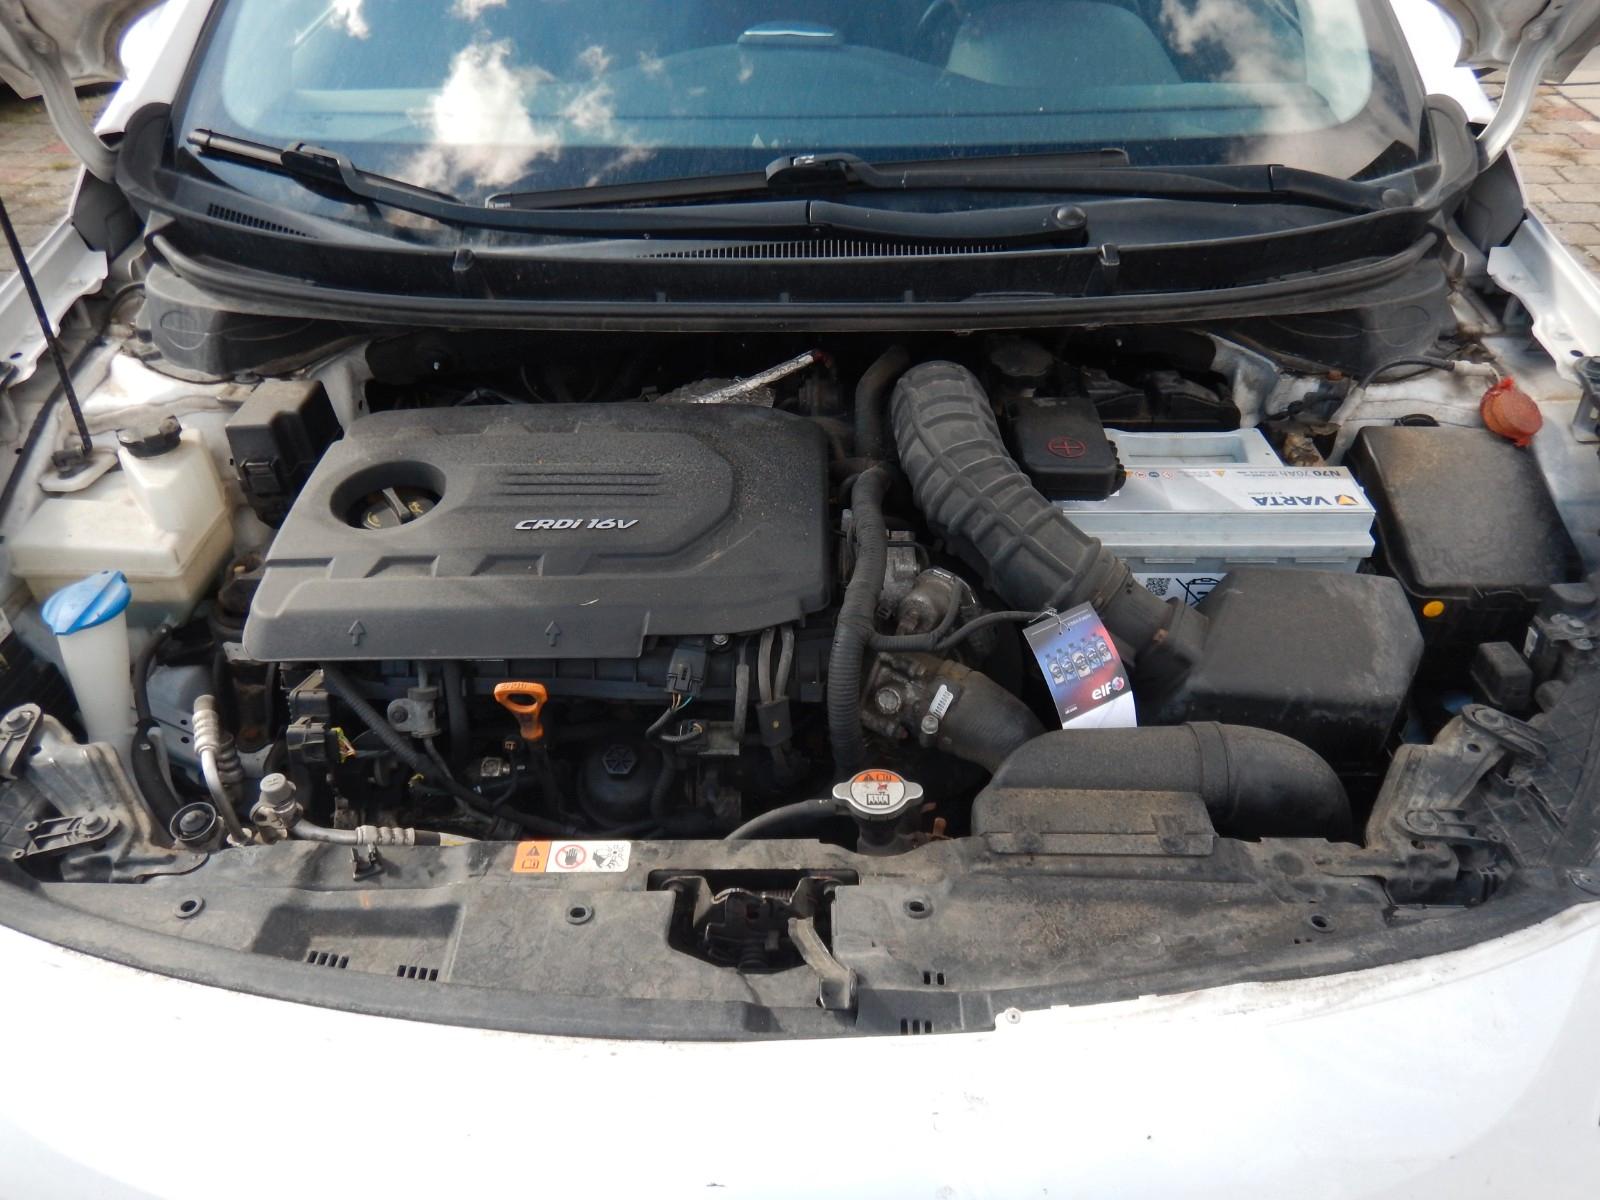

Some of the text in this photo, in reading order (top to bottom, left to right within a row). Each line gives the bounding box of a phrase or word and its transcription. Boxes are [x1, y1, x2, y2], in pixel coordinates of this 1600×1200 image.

[1250, 495, 1332, 506] VARTA
[586, 518, 639, 530] 16V
[1091, 681, 1113, 700] elf
